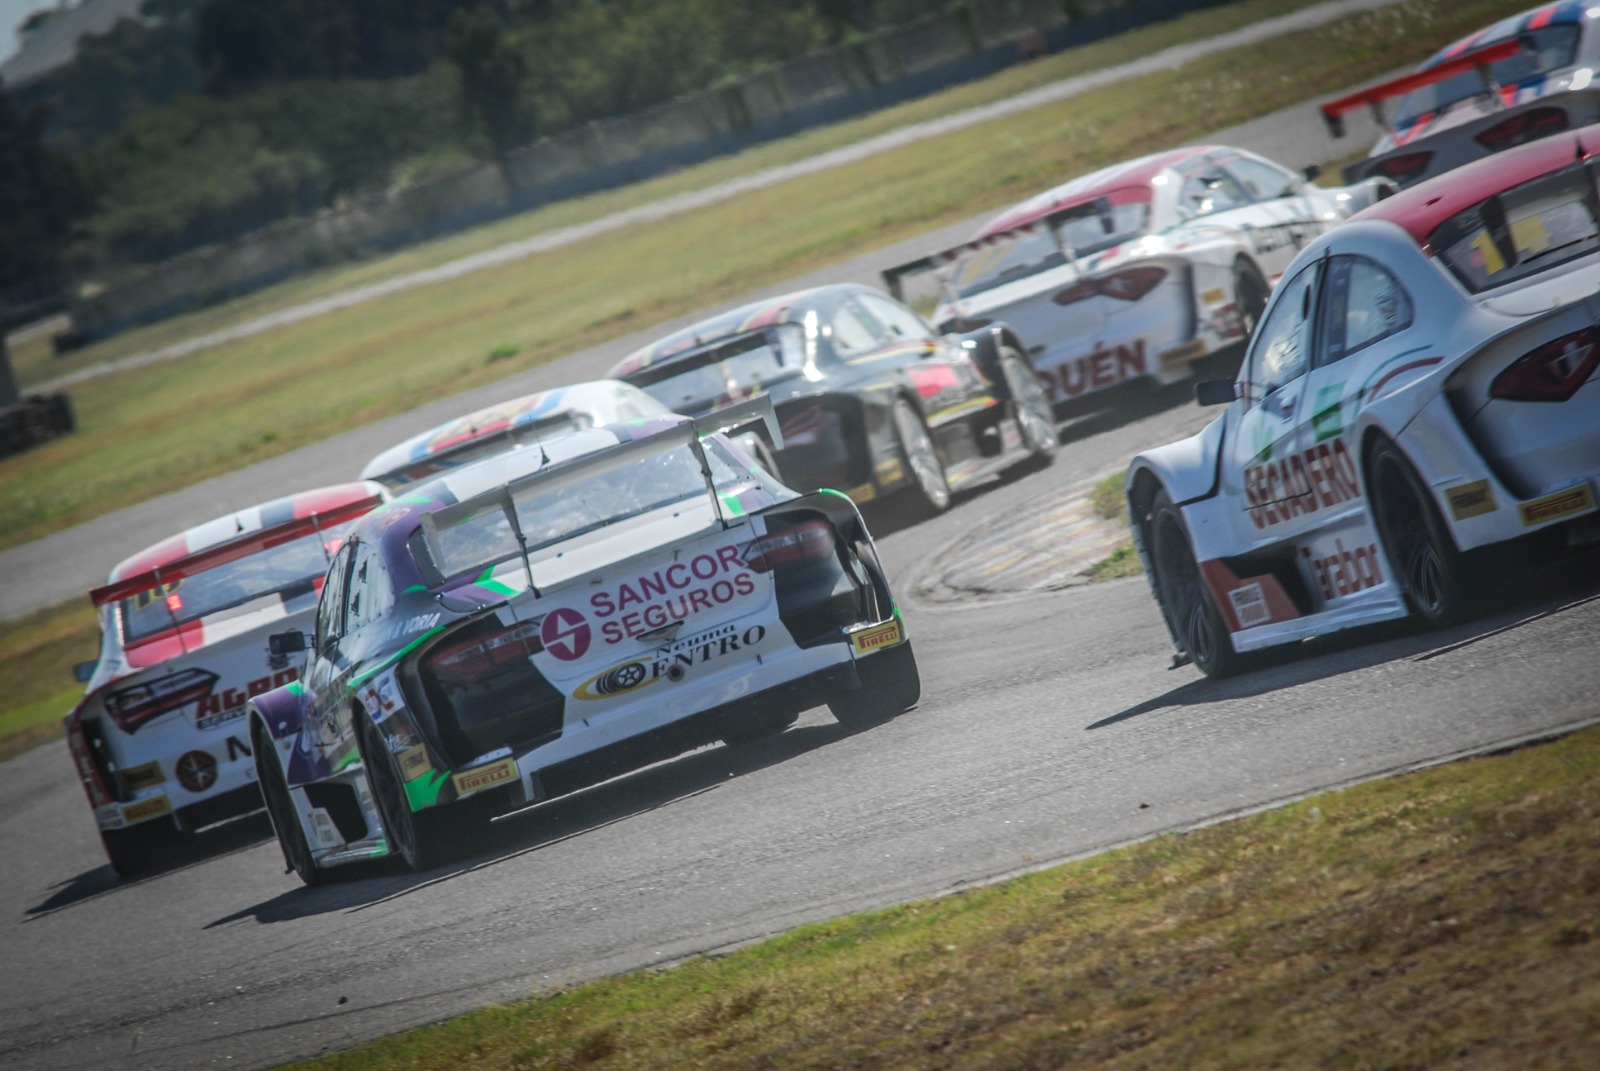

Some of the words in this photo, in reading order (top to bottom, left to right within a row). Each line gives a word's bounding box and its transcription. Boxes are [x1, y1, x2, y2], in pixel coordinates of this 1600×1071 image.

[590, 544, 749, 618] SANCOR
[601, 571, 755, 645] SEGUROS
[655, 623, 737, 659] Neuma
[857, 625, 898, 650] PIRELLI
[457, 762, 512, 791] PIRELLI
